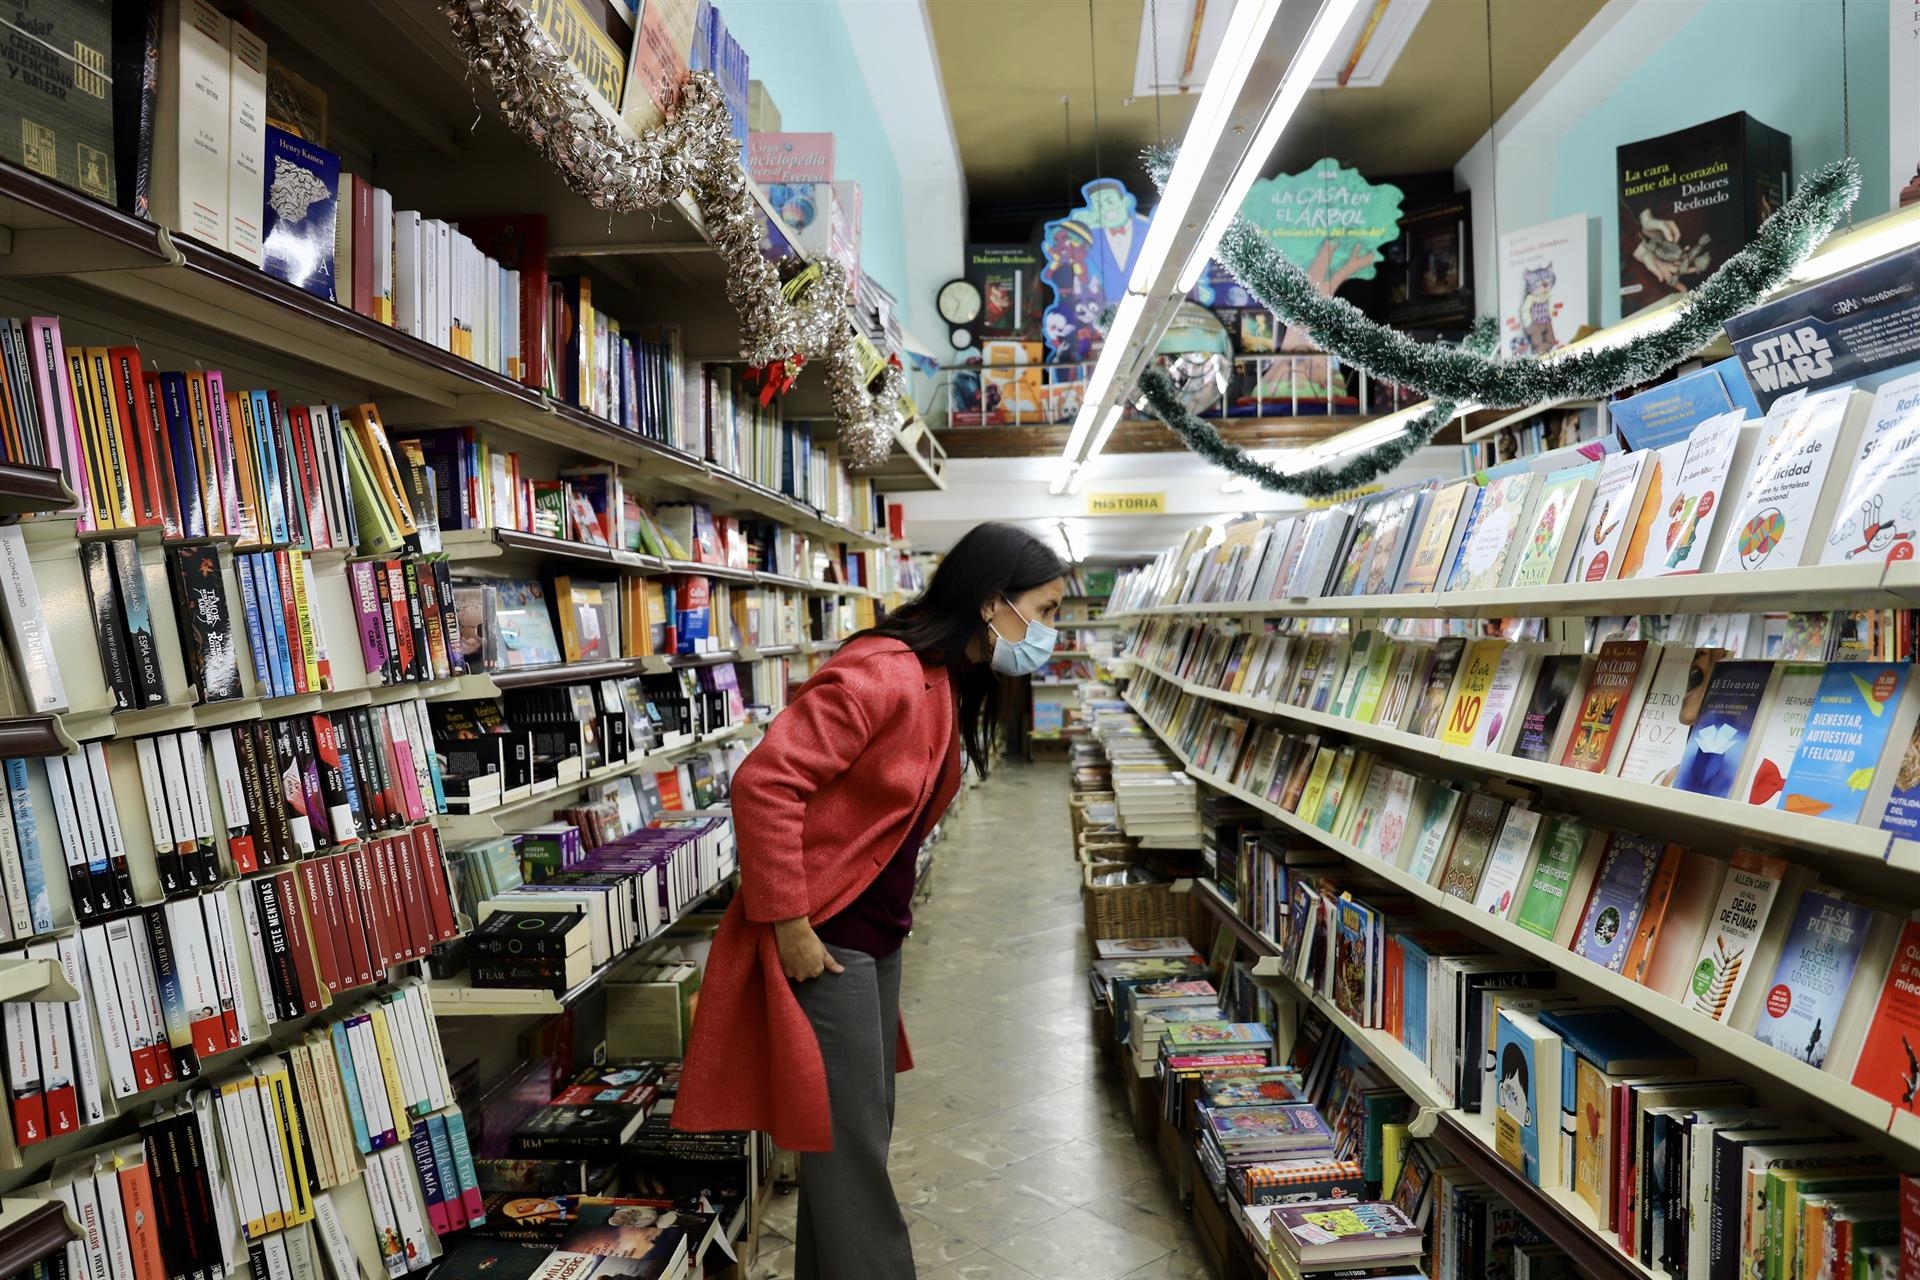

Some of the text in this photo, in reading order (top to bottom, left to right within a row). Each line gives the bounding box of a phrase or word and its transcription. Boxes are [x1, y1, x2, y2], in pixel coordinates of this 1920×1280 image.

[21, 68, 67, 101] BALEAR
[280, 138, 324, 165] Henry Kamen
[1624, 161, 1728, 196] norte del corazón
[1625, 163, 1670, 182] La cara
[1296, 187, 1371, 207] CASA EN
[1682, 176, 1729, 197] Dolores
[1673, 191, 1729, 213] Redondo
[1276, 208, 1292, 222] EL
[973, 256, 1035, 264] Dolores Redondo
[43, 329, 55, 370] Nabokov Lolita
[1747, 327, 1829, 370] STAR
[95, 358, 103, 379] sombrero
[1751, 351, 1833, 392] WARS
[110, 447, 118, 464] hombre
[1807, 440, 1822, 453] de
[1780, 480, 1810, 491] fortaleza
[1093, 498, 1158, 509] HISTORIA
[356, 570, 372, 613] MUERTOS
[387, 569, 401, 602] ENDER
[21, 618, 46, 670] EL PACIENTE
[300, 614, 315, 664] MUNDO AMARILLO
[367, 630, 375, 647] CARD
[372, 616, 384, 659] ORSON SCOTT
[405, 639, 413, 657] SCOTT
[137, 634, 156, 683] ESPÍA DIOS
[1595, 660, 1636, 673] LOS CUATRO
[1594, 674, 1629, 686] ACUERDOS
[1712, 680, 1760, 690] El Elemento
[1646, 693, 1679, 706] EL TAO
[1449, 695, 1481, 734] NO
[1642, 709, 1665, 720] DE LA
[1813, 713, 1862, 730] BIENESTAR,
[277, 738, 285, 754] MOLA
[295, 735, 303, 751] MOLA
[301, 731, 310, 754] CARMEN
[324, 727, 334, 750] CARMEN
[1806, 730, 1863, 746] AUTOESTIMA
[1802, 746, 1855, 763] Y FELICIDAD
[11, 760, 29, 819] Manuel Vicent
[243, 732, 270, 842] PAN LIMÓN SEMILLAS AMAPOLA
[243, 766, 256, 811] CRISTINA CAMPOS
[263, 729, 288, 838] PAN LIMÓN SEMILLAS AMAPOLA
[263, 763, 275, 808] CRISTINA CAMPOS
[302, 771, 312, 797] PÚRPURA
[327, 770, 336, 790] GITANA
[334, 774, 343, 791] NOVIA
[338, 753, 360, 812] JOHN VERDON
[1891, 806, 1903, 816] DEL
[90, 841, 98, 856] Donna
[111, 837, 119, 852] Donna
[421, 830, 434, 867] VARGAS LLOSA
[1549, 847, 1569, 863] Recetas
[373, 846, 387, 885] VARGAS LLOSA
[385, 843, 398, 882] VARGAS LLOSA
[398, 841, 411, 880] VARGAS LLOSA
[304, 867, 317, 901] SARAMAGO
[321, 863, 334, 896] SARAMAGO
[338, 860, 350, 892] SARAMAGO
[353, 857, 366, 890] SARAMAGO
[1534, 879, 1544, 890] tus
[1537, 864, 1570, 882] para mejorar
[1734, 874, 1770, 892] ALLEN CARR
[282, 879, 295, 915] SARAMAGO
[1731, 897, 1757, 915] DEJAR
[261, 882, 285, 952] SIETE MENTIRAS
[1720, 909, 1757, 932] DE FUMAR
[1821, 905, 1850, 926] ELSA
[1726, 926, 1737, 935] SABES
[1807, 917, 1855, 943] PUNSET
[150, 911, 176, 1003] ALTA JAVIER CERCAS
[1815, 940, 1833, 956] UNA
[64, 951, 75, 982] MONTERO
[1799, 960, 1833, 979] PARA EL
[1800, 948, 1840, 972] MOCHILA
[1900, 962, 1908, 973] si
[477, 967, 505, 982] FEAR
[1791, 971, 1834, 996] UNIVERSO
[130, 999, 138, 1018] Montero
[149, 995, 158, 1014] Montero
[105, 1002, 120, 1047] ROSA MONTERO
[17, 1041, 28, 1077] Clara Sánchez
[431, 1134, 451, 1165] CULPA
[450, 1131, 470, 1163] CULPA
[413, 1140, 437, 1195] CULPA MÍA
[84, 1203, 100, 1249] DAVID SAFIER
[268, 1245, 283, 1268] JAVIER
[291, 1238, 305, 1262] JAVIER
[92, 1253, 106, 1278] KARMA
[250, 1250, 267, 1276] JAVIER
